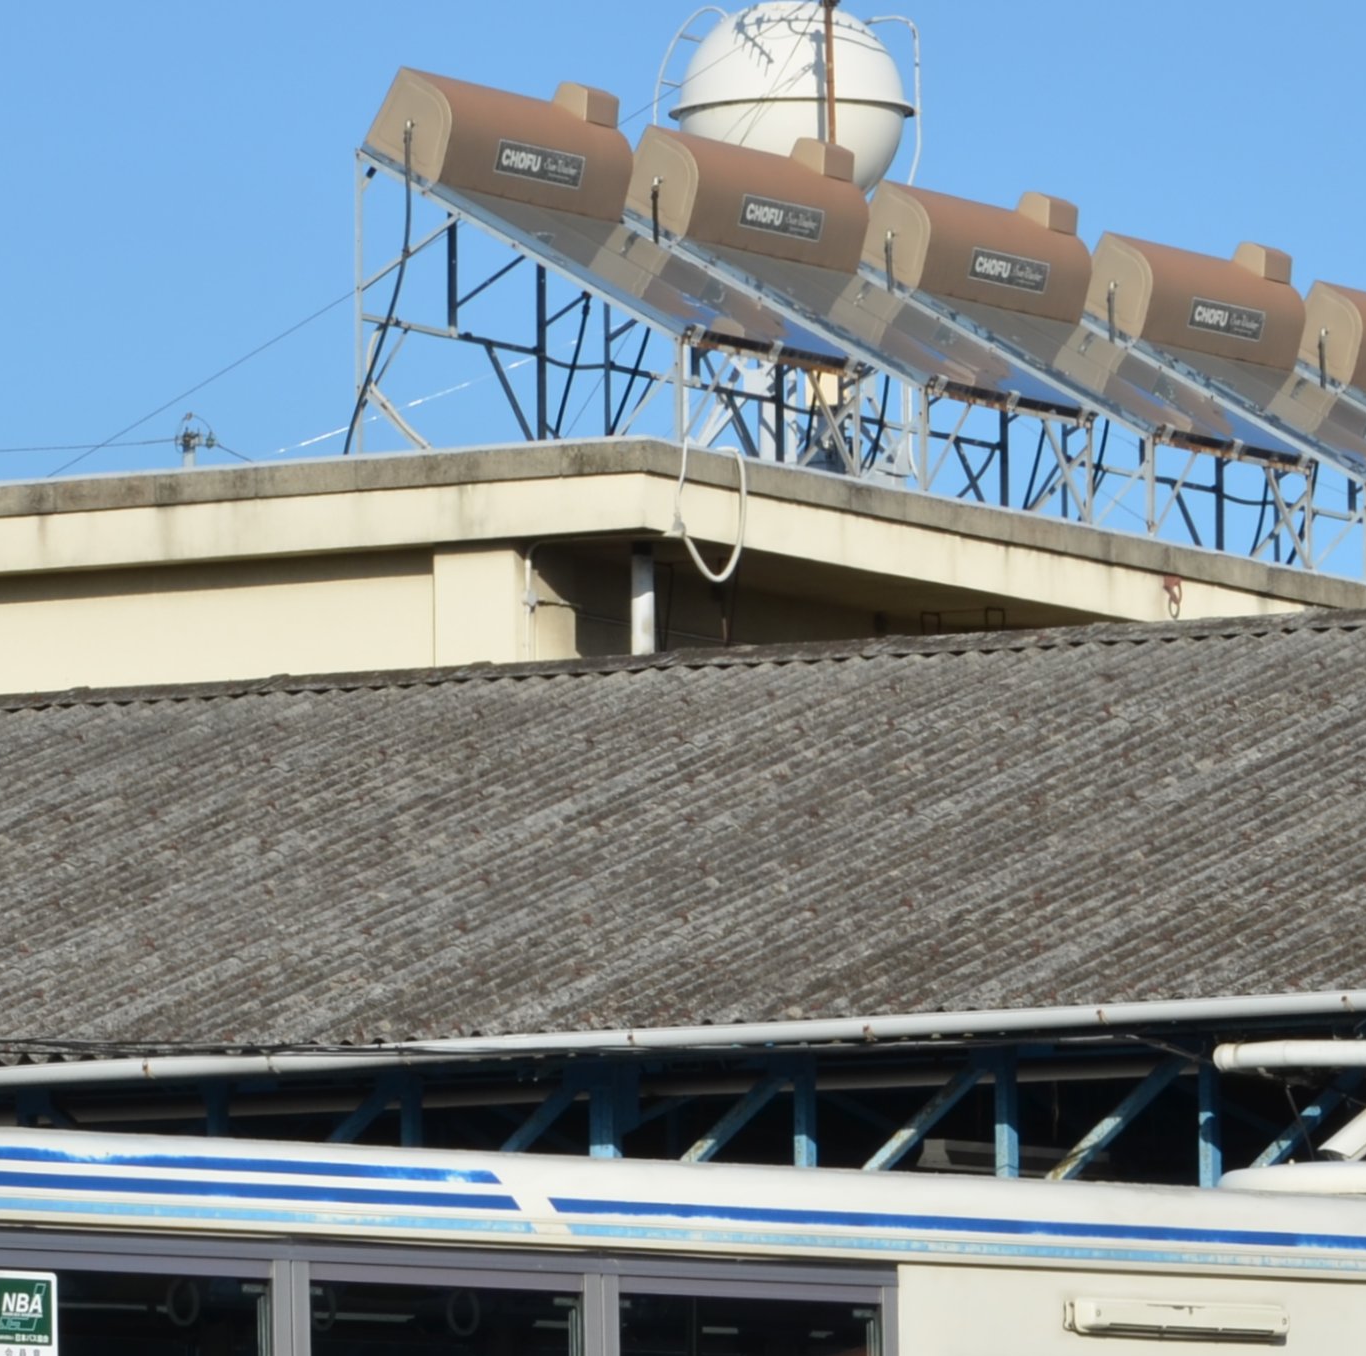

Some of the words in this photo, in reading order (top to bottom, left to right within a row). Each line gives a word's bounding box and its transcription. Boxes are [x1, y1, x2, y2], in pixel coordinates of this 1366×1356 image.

[501, 148, 542, 172] CHOFU
[745, 203, 784, 226] CHOFU
[975, 256, 1012, 278] CHOFU
[1194, 305, 1229, 327] CHOFU
[1, 1291, 43, 1314] NBA
